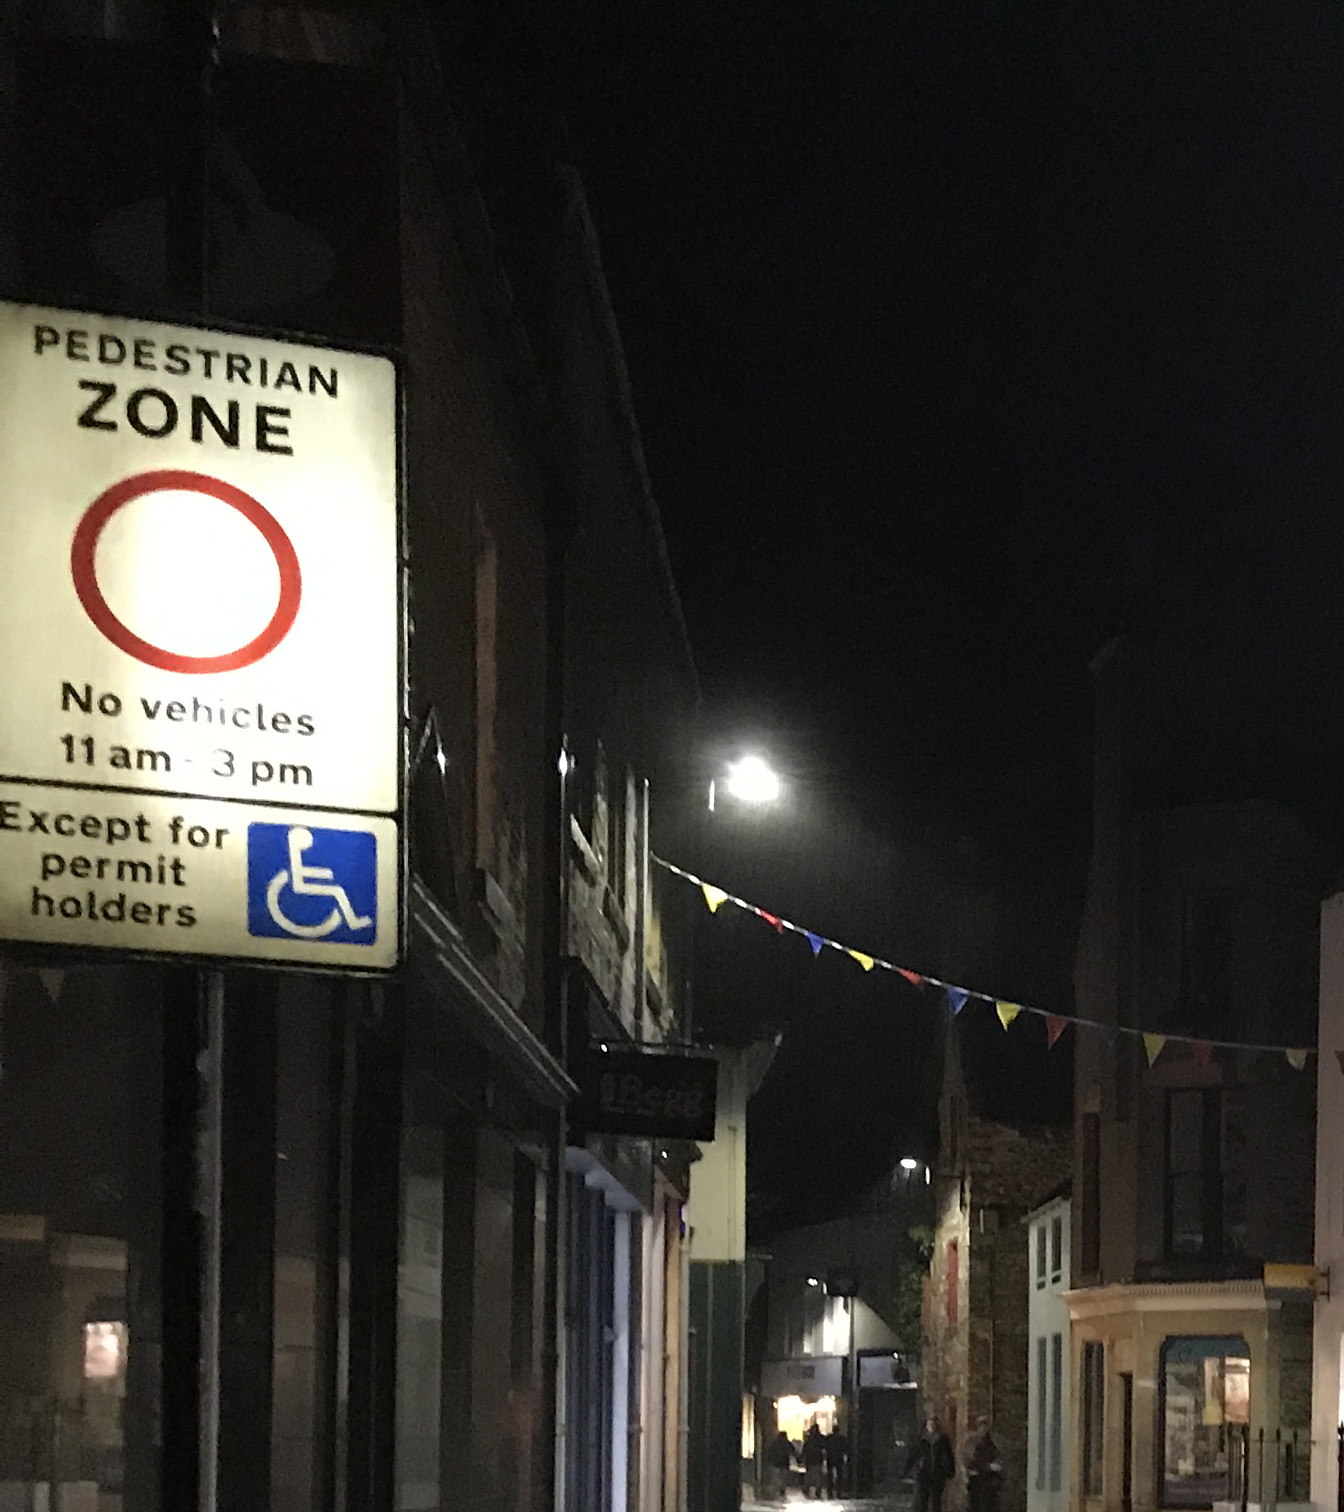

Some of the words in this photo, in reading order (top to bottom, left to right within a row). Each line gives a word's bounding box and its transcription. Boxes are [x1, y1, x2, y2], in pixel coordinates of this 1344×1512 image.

[33, 325, 339, 398] PEDESTRIAN
[77, 379, 294, 456] ZONE
[60, 681, 123, 717] No
[140, 696, 316, 736] vehicles
[0, 801, 152, 845] Except
[168, 816, 231, 850] for
[40, 851, 187, 887] permit
[30, 887, 198, 928] holders
